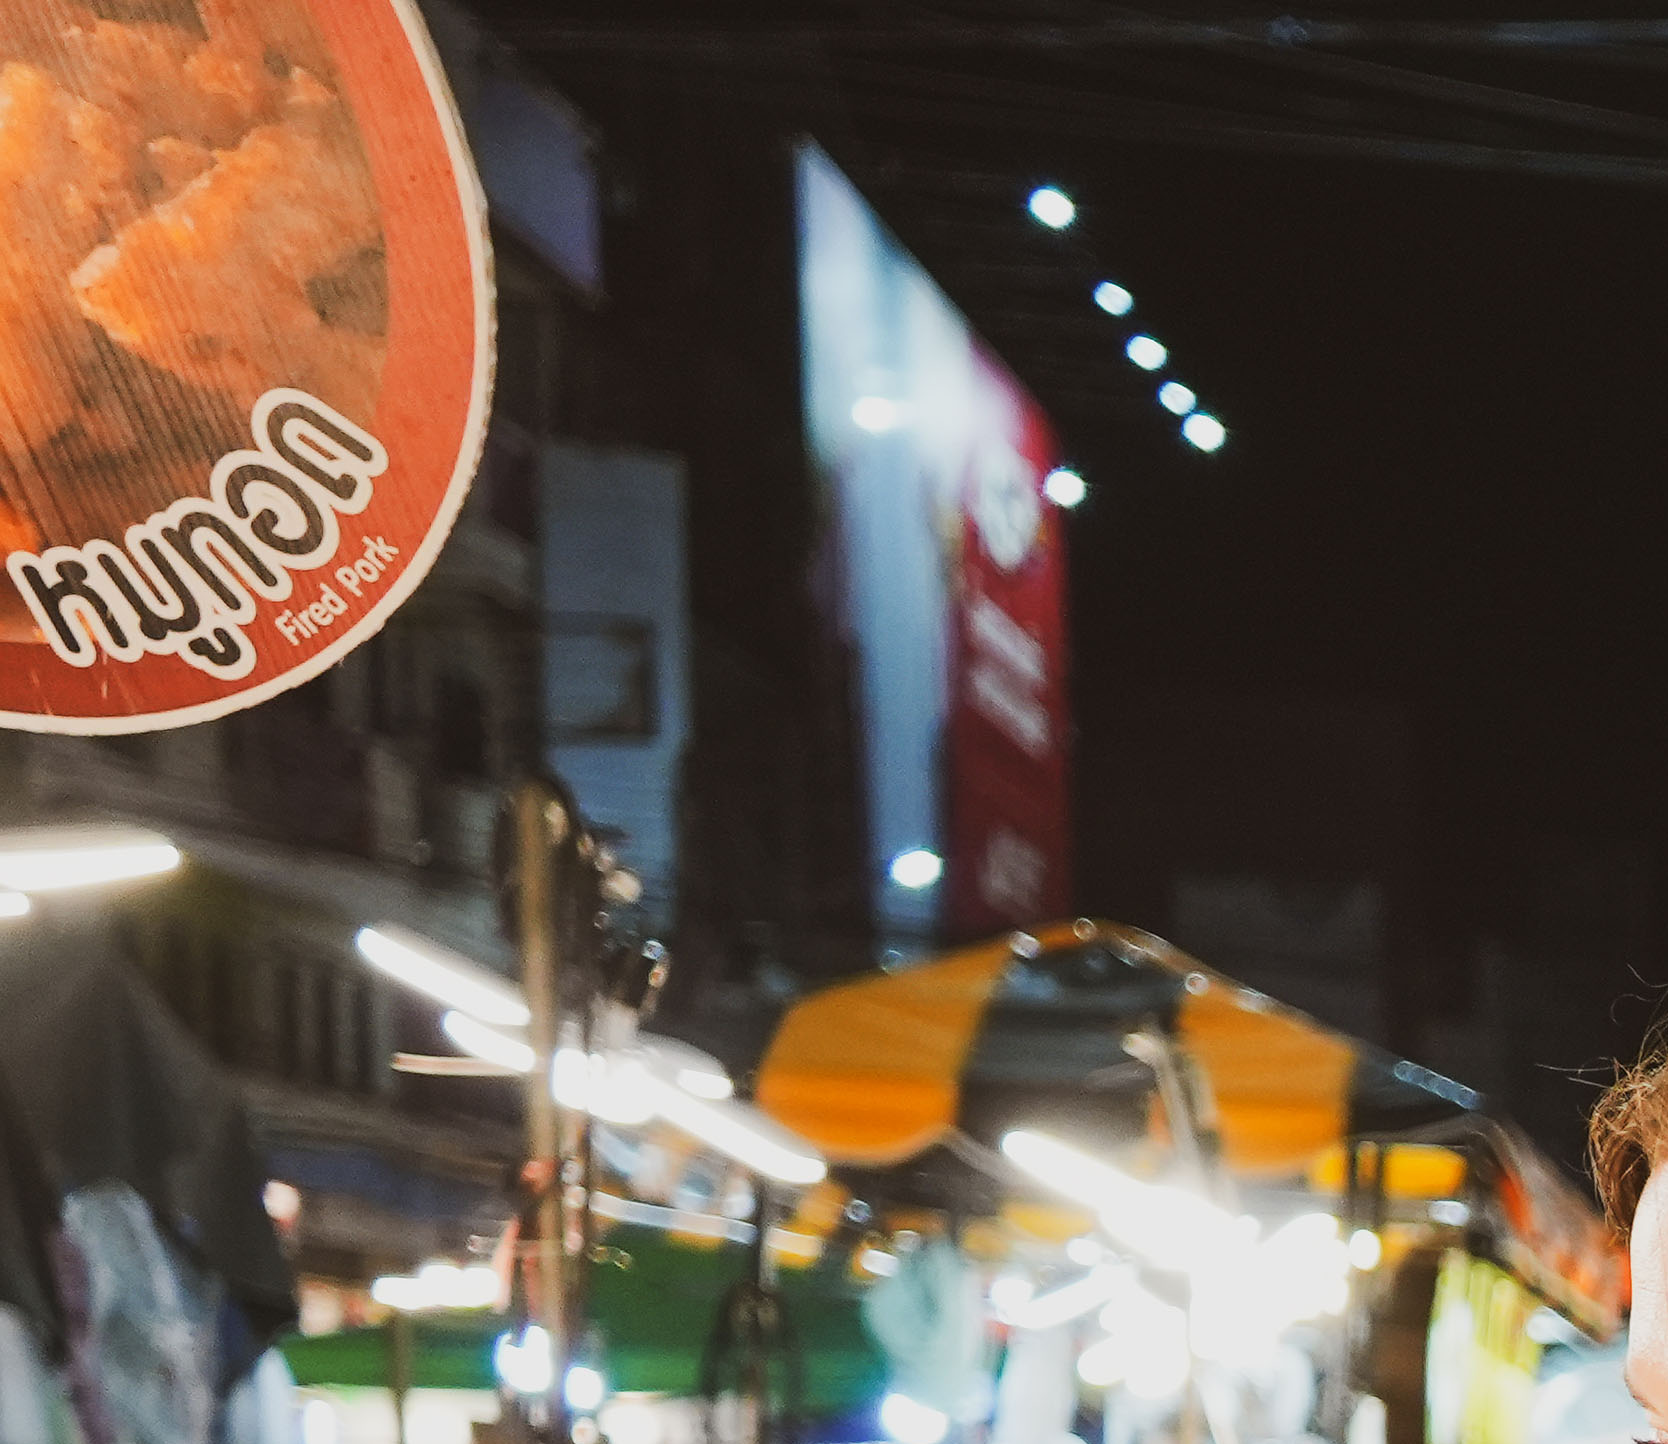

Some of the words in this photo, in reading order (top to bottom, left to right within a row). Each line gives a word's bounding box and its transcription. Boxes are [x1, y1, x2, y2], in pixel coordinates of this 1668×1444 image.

[16, 396, 382, 674] หมูทอด
[275, 580, 346, 647] Fired
[342, 533, 400, 595] Pork
